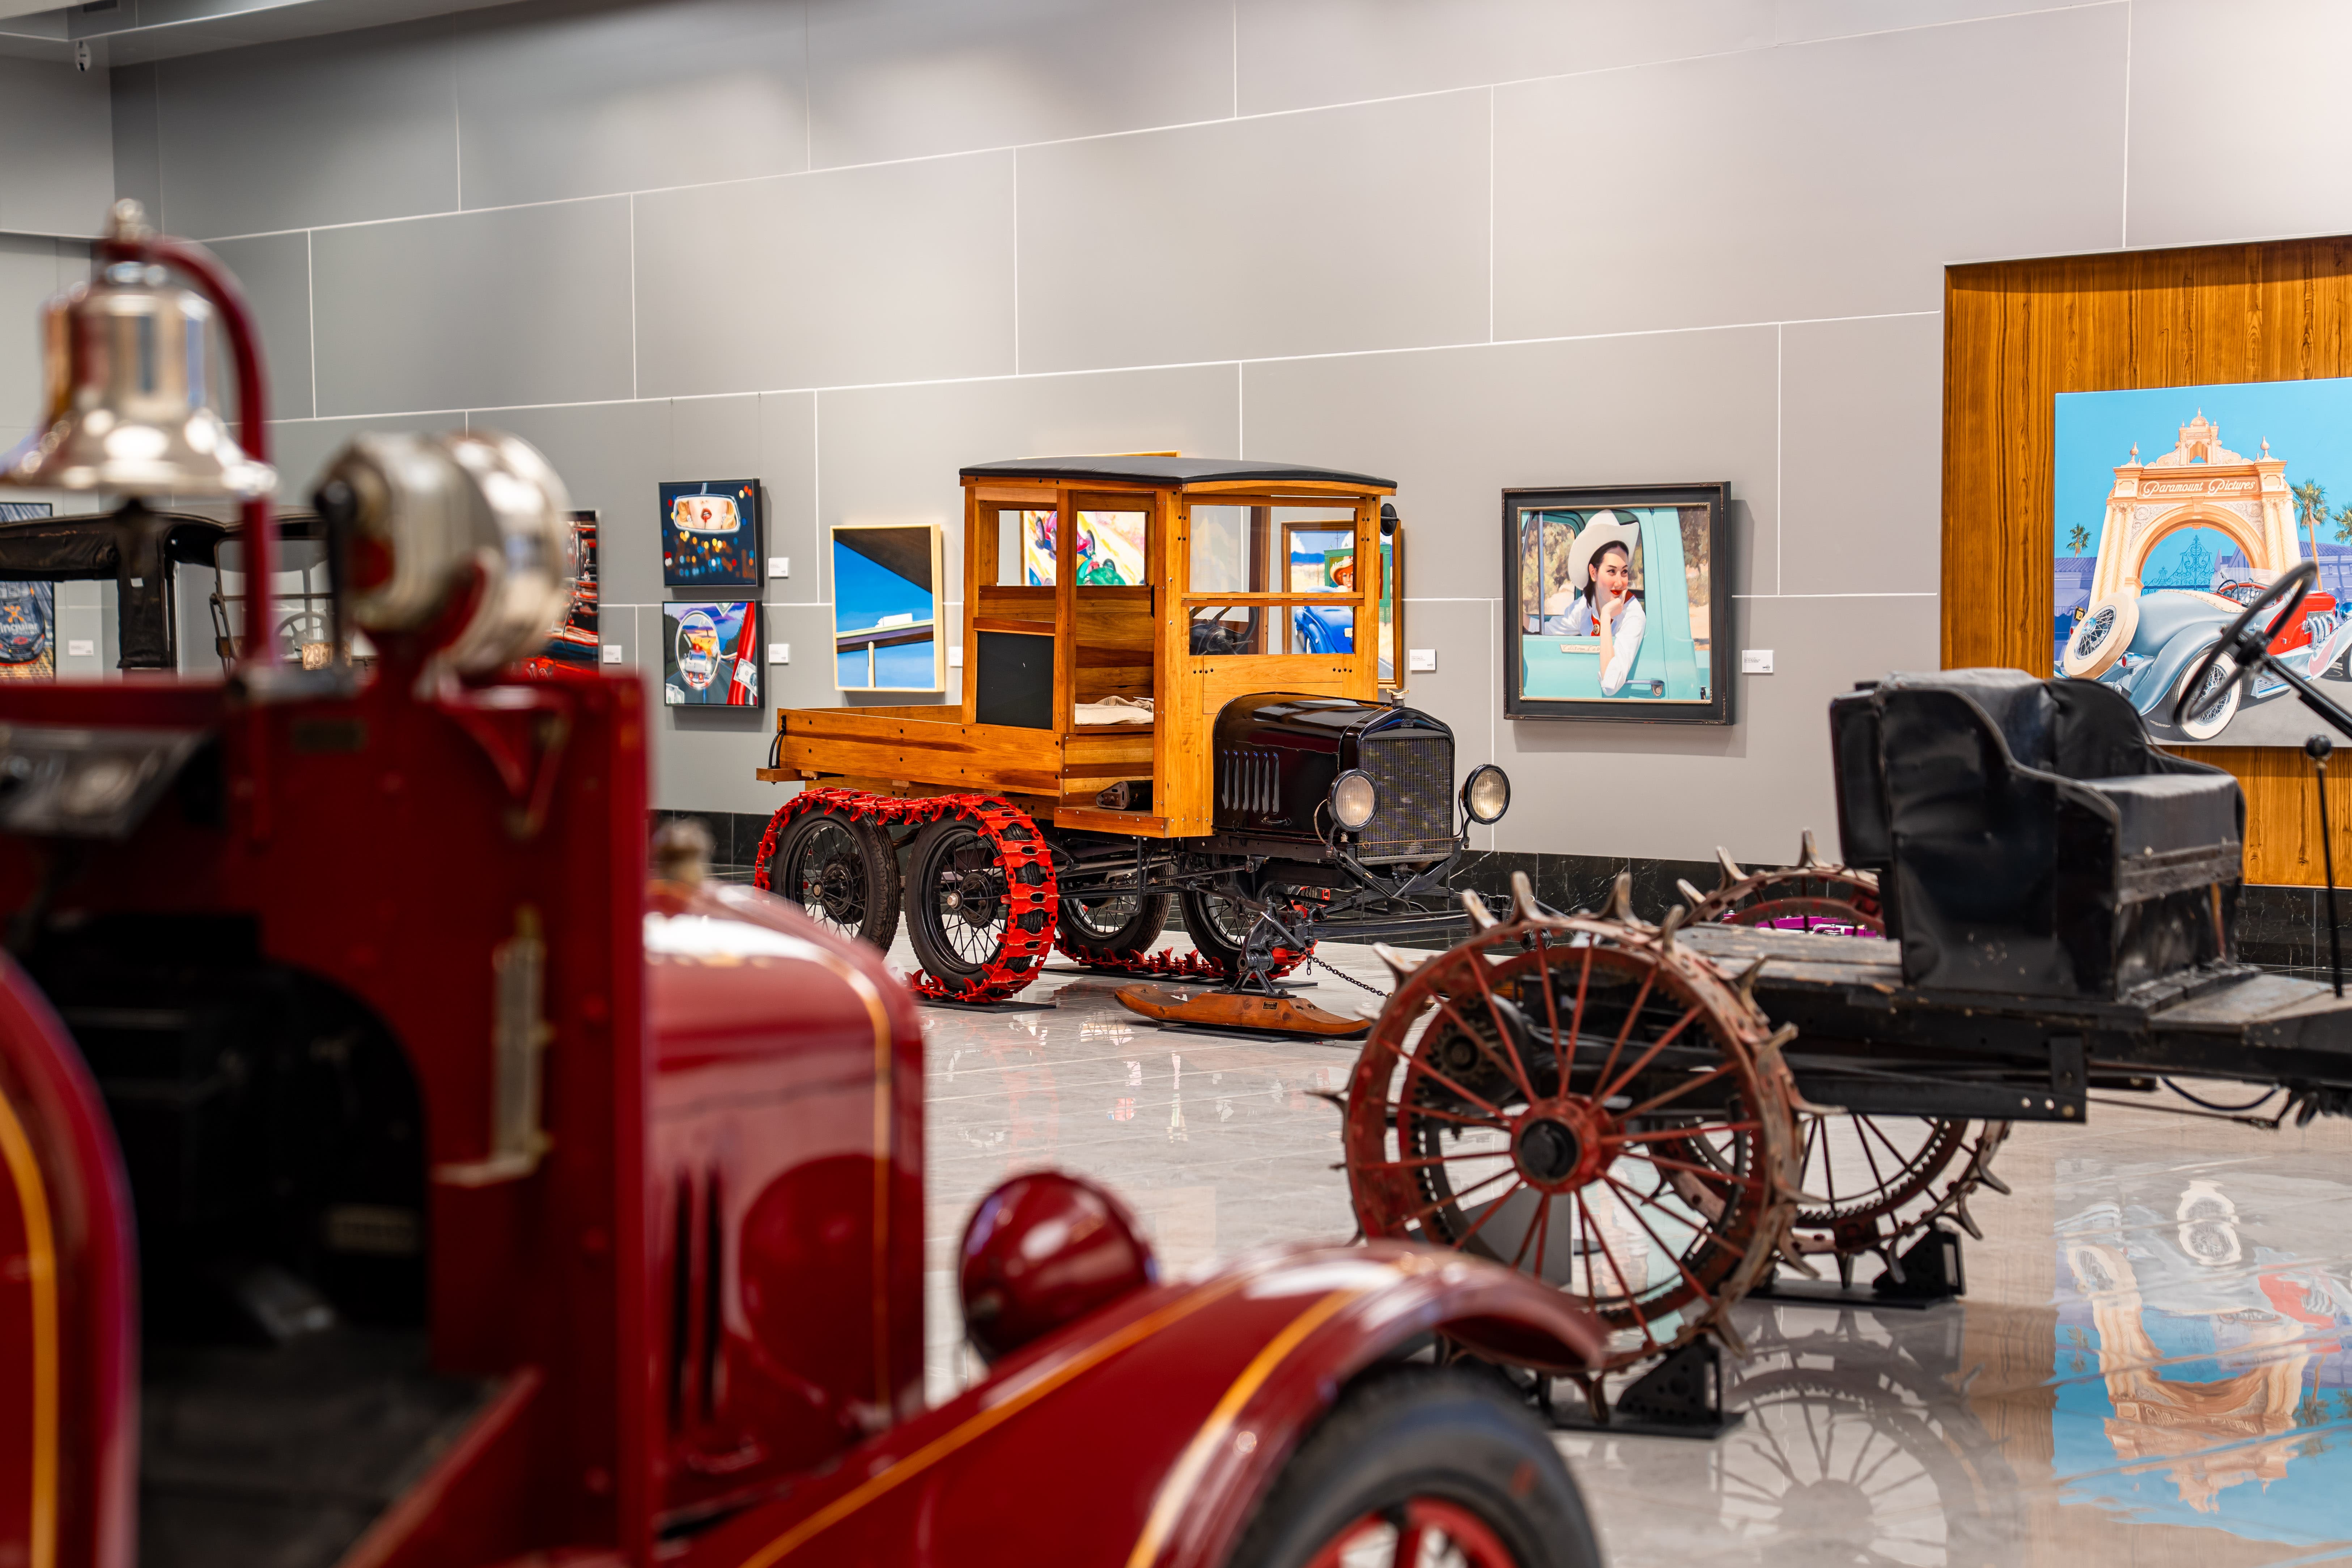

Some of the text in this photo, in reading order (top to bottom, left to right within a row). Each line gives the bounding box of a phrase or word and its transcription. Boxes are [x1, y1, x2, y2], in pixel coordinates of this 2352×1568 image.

[2143, 479, 2256, 497] Paramount Pictures
[0, 620, 38, 635] ingular
